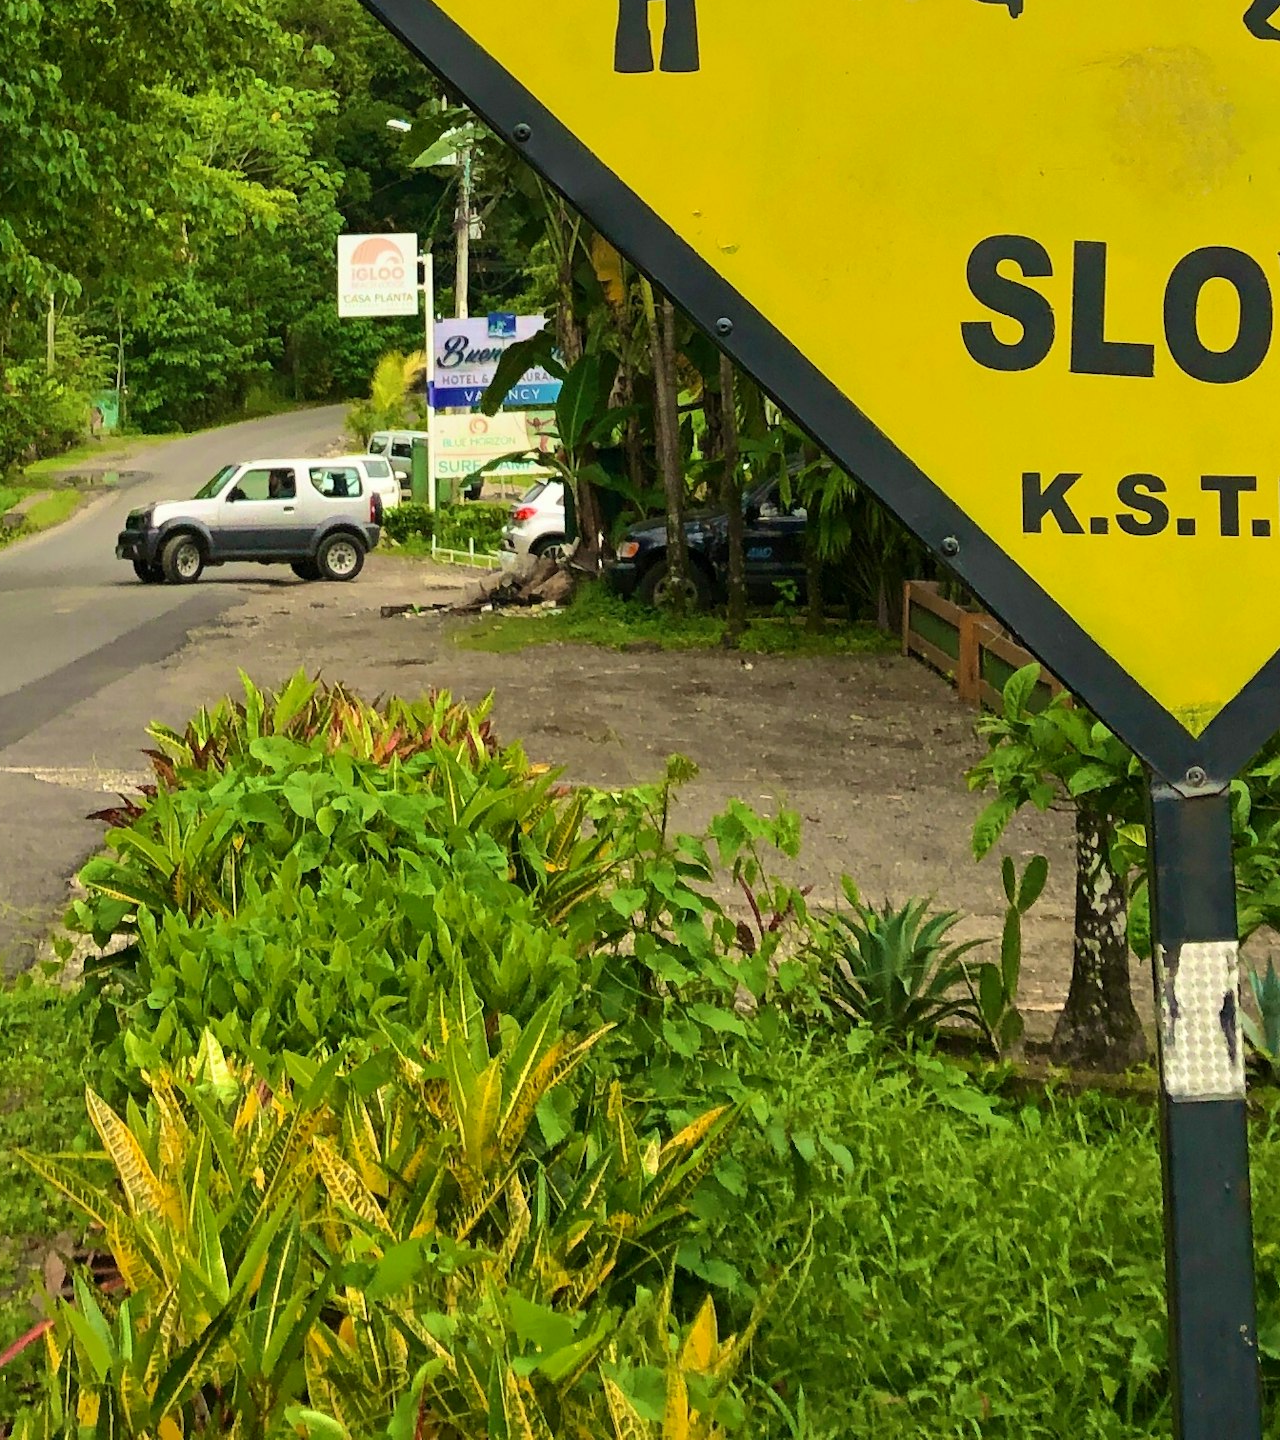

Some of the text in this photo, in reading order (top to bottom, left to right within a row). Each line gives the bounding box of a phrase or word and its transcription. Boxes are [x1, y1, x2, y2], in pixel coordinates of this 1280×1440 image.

[343, 292, 413, 304] CASA PLANTA
[442, 374, 489, 385] HOTEL &
[464, 389, 540, 402] VANCY
[443, 436, 516, 448] BLUE HORIZON
[439, 460, 482, 474] SURF
